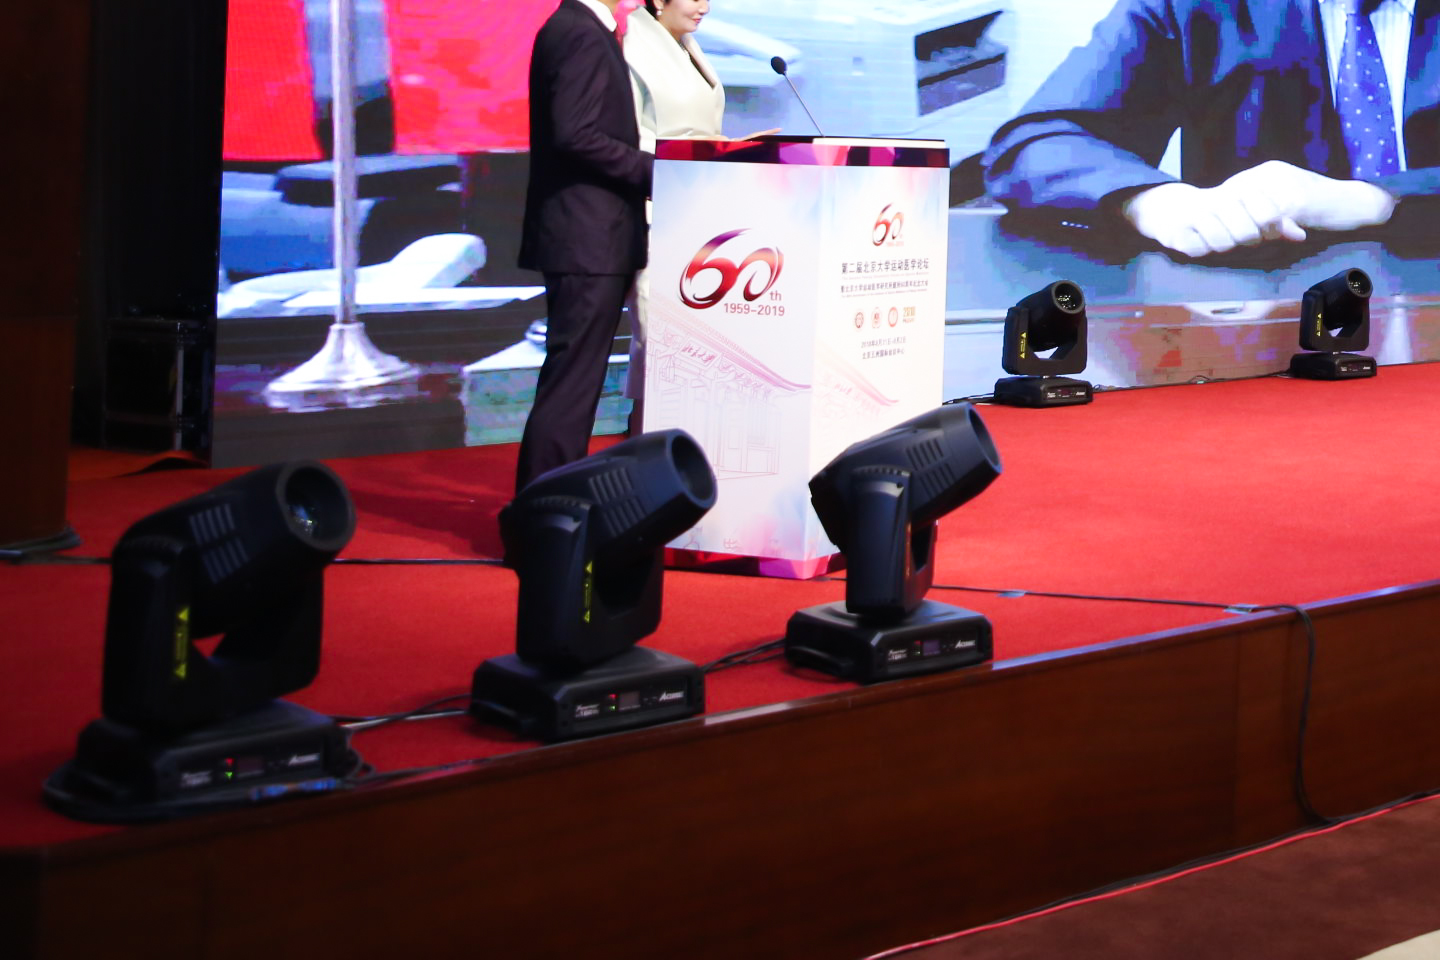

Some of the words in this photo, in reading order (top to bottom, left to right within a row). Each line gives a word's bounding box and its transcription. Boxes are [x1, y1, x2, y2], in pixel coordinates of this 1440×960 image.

[841, 258, 929, 275] 第二届北京大学运动医学论坛
[769, 290, 782, 301] th
[723, 303, 785, 317] 1959-2019
